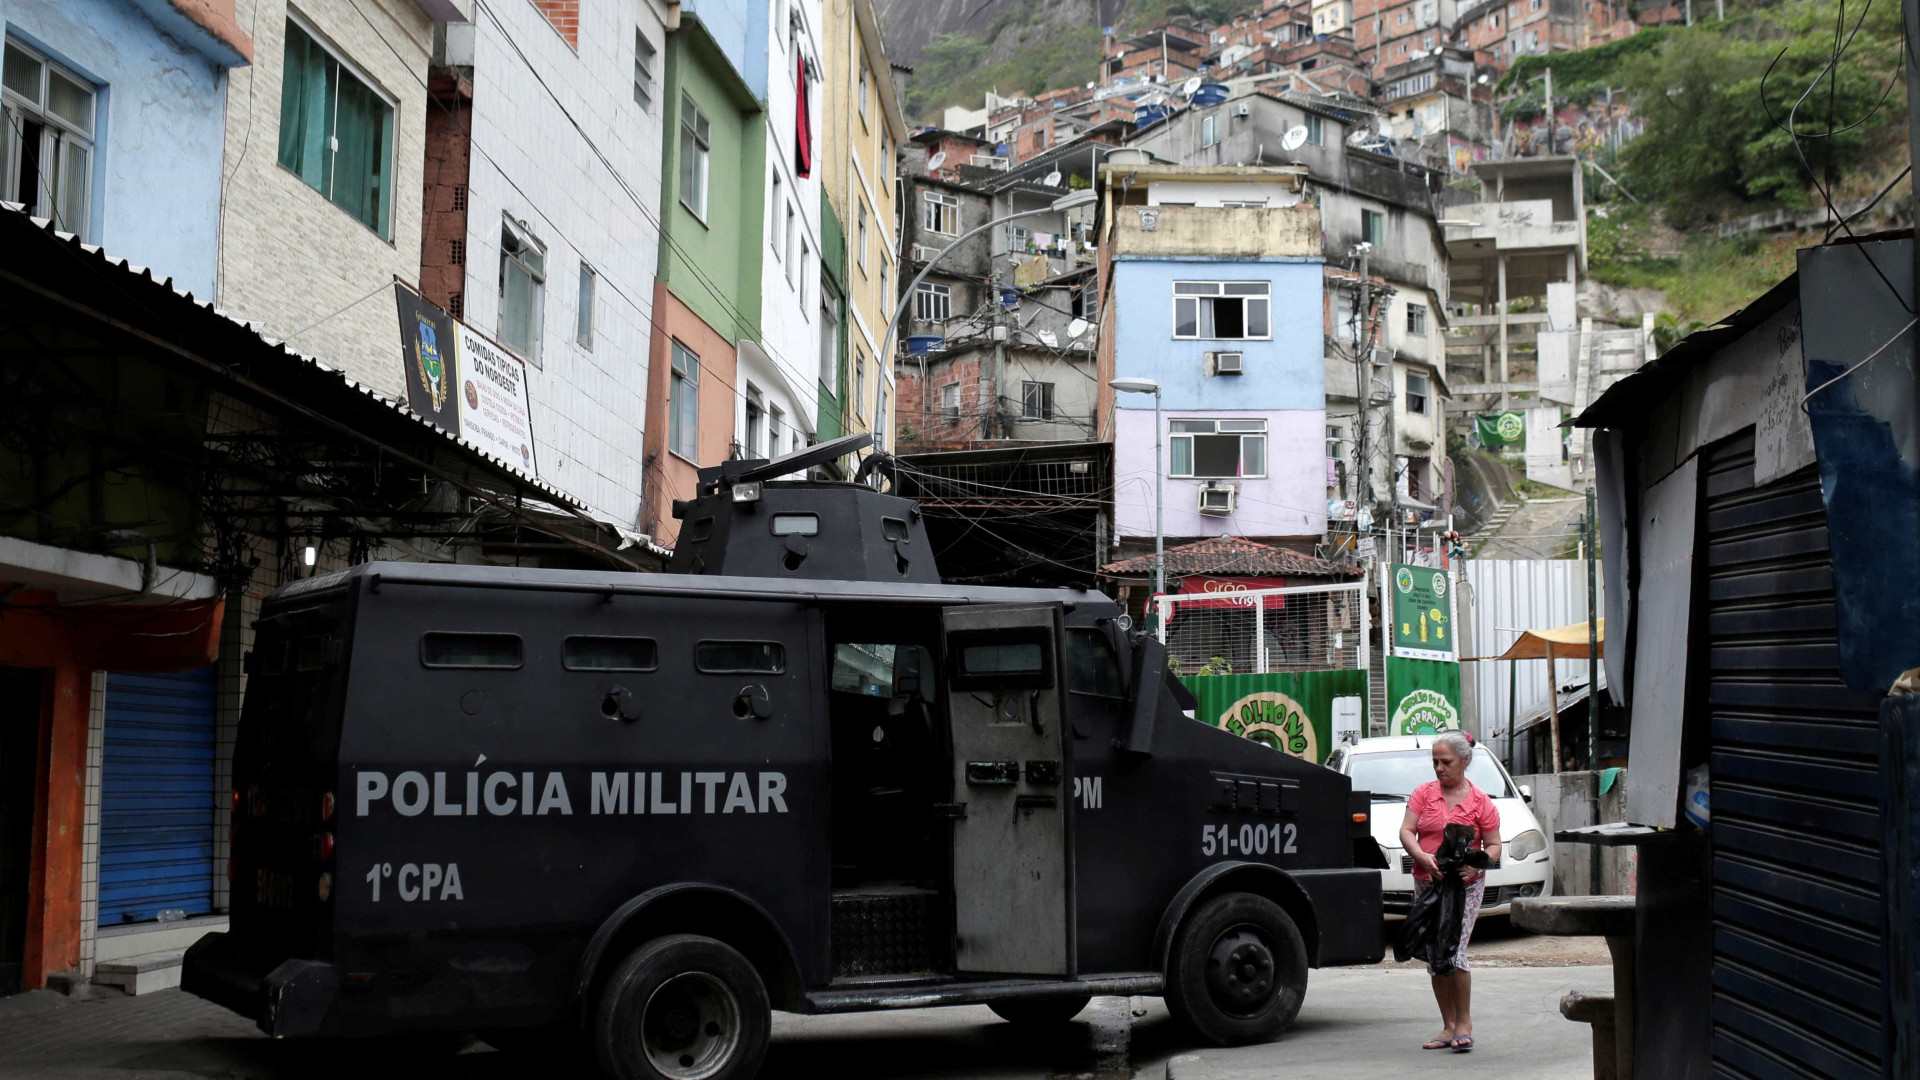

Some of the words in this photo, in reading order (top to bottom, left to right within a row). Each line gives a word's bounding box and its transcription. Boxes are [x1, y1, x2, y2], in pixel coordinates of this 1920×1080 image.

[465, 335, 496, 367] COMIDAS
[473, 357, 484, 375] DO
[484, 364, 516, 397] NORDESTE
[1241, 700, 1287, 726] OLHO
[1283, 711, 1307, 753] NO
[356, 753, 573, 816] POLÍCIA
[590, 771, 789, 814] MILITAR
[1201, 823, 1298, 856] 51-0012
[398, 862, 464, 901] CPA
